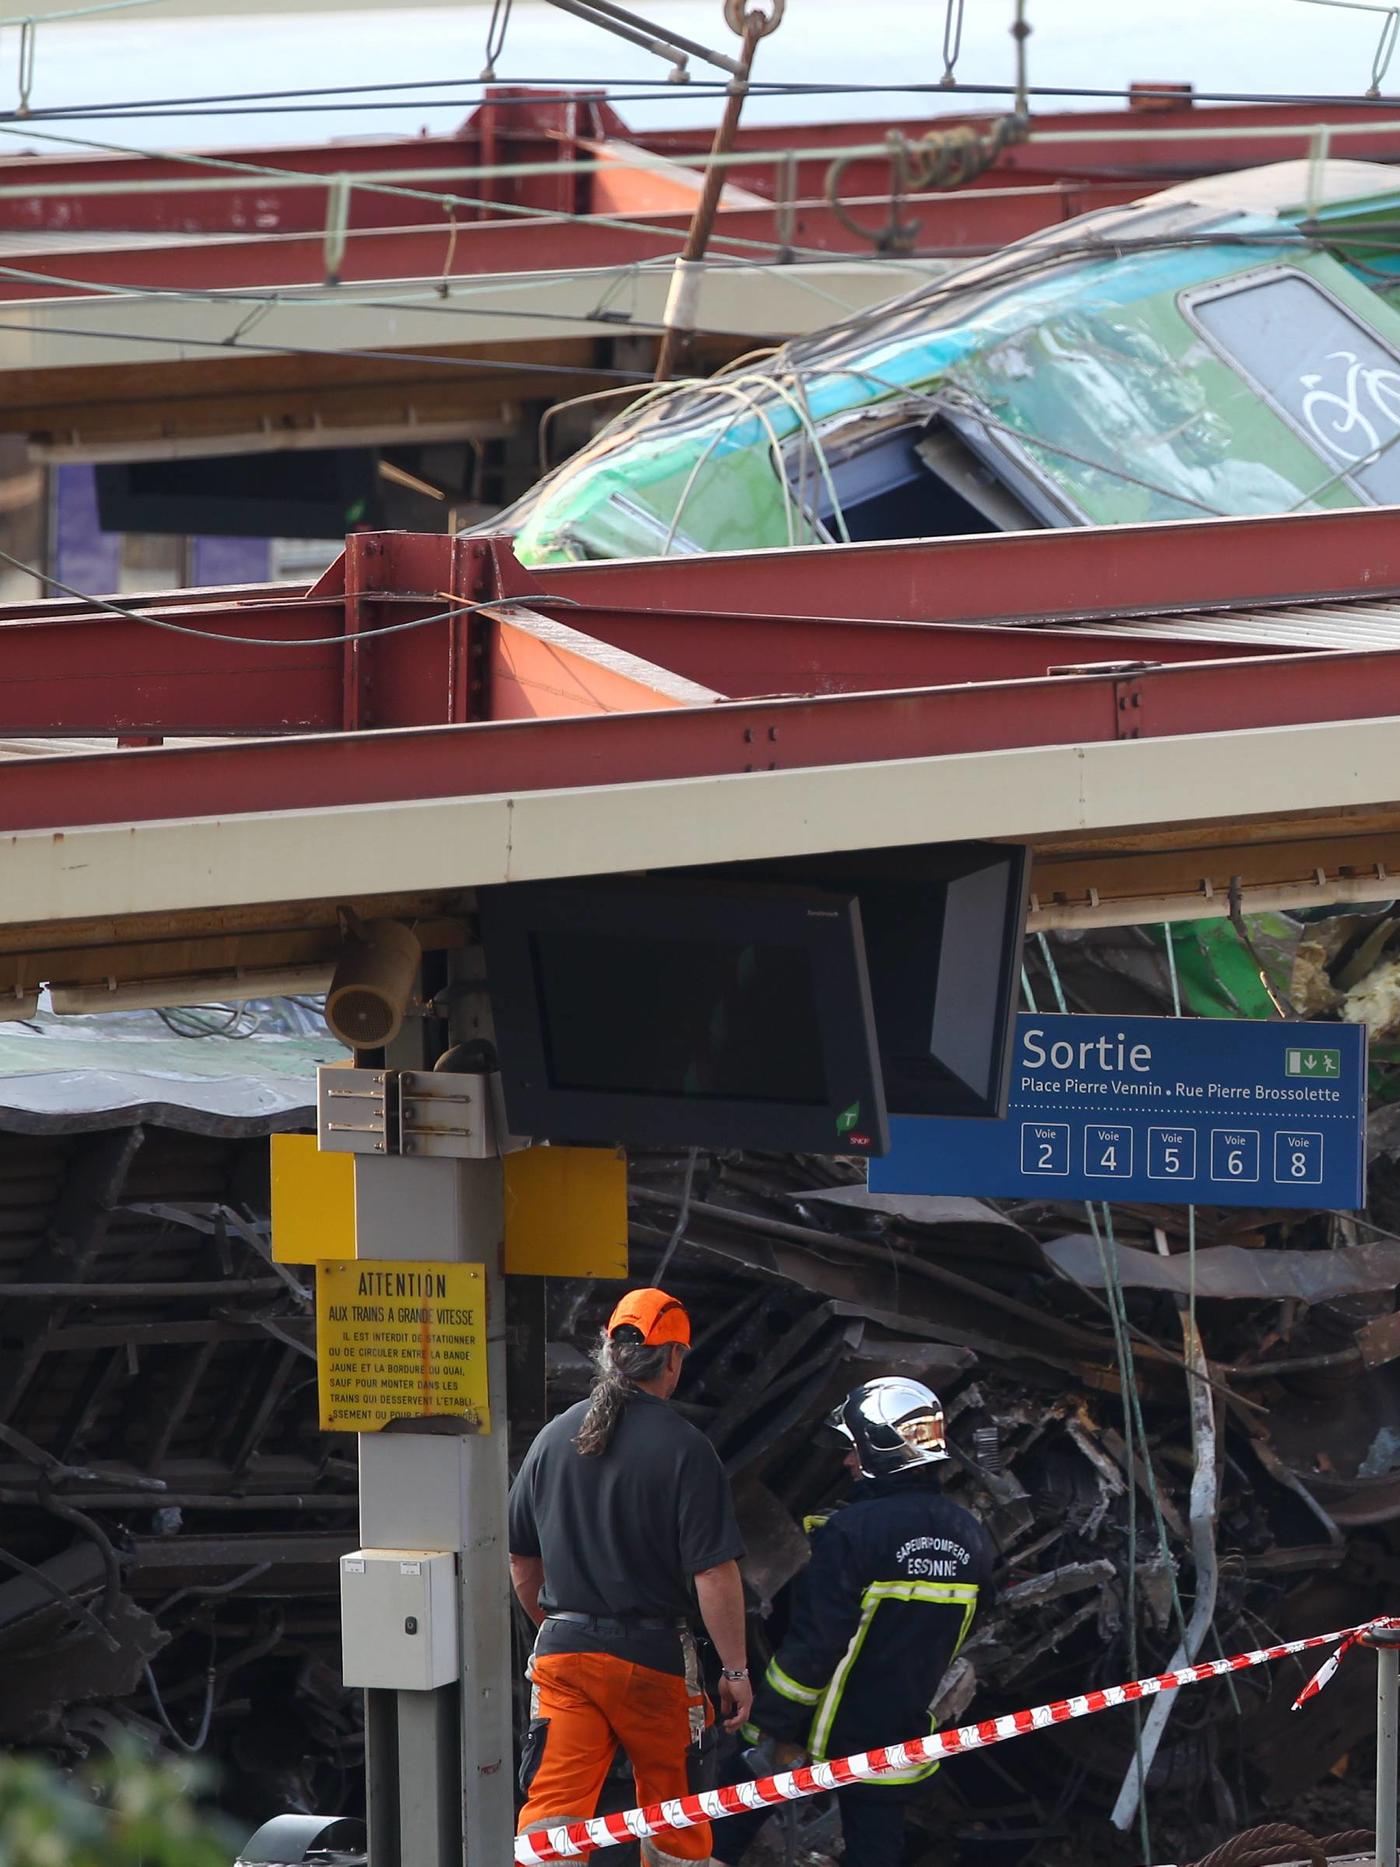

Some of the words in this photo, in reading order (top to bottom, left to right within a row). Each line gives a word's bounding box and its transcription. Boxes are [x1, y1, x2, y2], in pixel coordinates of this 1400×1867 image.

[1022, 1029, 1152, 1072] Sortie
[1021, 1077, 1060, 1092] Place
[1065, 1078, 1108, 1094] Pierre
[1111, 1080, 1161, 1096] Vennin
[1176, 1082, 1203, 1097] Rue
[1208, 1083, 1250, 1099] Pierre
[1255, 1085, 1340, 1102] Brossolette
[1035, 1129, 1056, 1139] Voie
[1098, 1130, 1120, 1141] Voie
[1161, 1133, 1183, 1143] Voie
[1224, 1135, 1246, 1146] Voie
[1288, 1137, 1310, 1148] Voie
[1038, 1143, 1053, 1169] 2
[1100, 1146, 1117, 1171] 4
[1164, 1148, 1180, 1173] 5
[1227, 1150, 1243, 1175] 6
[1290, 1152, 1306, 1178] 8
[358, 1272, 446, 1298] ATTENTION
[329, 1306, 348, 1321] AUX
[352, 1306, 384, 1323] TRAINS
[388, 1307, 394, 1323] A
[398, 1308, 433, 1324] GRANDE
[437, 1309, 473, 1326] VITESSE
[343, 1332, 350, 1341] IL
[354, 1332, 369, 1341] EST
[373, 1333, 408, 1342] INTERDIT
[412, 1334, 422, 1343] DE
[427, 1334, 475, 1345] STATIONNER
[329, 1348, 340, 1357] OU
[344, 1348, 355, 1357] DE
[359, 1348, 398, 1357] CIRCULER
[402, 1349, 427, 1359] ENTRE
[431, 1350, 440, 1359] LA
[444, 1351, 470, 1360] BANDE
[329, 1363, 357, 1372] JAUNE
[361, 1364, 371, 1372] ET
[374, 1364, 385, 1373] LA
[388, 1364, 424, 1374] BORDURE
[329, 1378, 351, 1387] SAUF
[356, 1379, 377, 1388] POUR
[381, 1379, 414, 1389] MONTER
[418, 1380, 439, 1390] DANS
[443, 1381, 458, 1390] LES
[330, 1394, 360, 1403] TRAINS
[363, 1395, 377, 1404] QUI
[380, 1395, 433, 1405] DESSERVENT
[375, 1411, 387, 1420] OU
